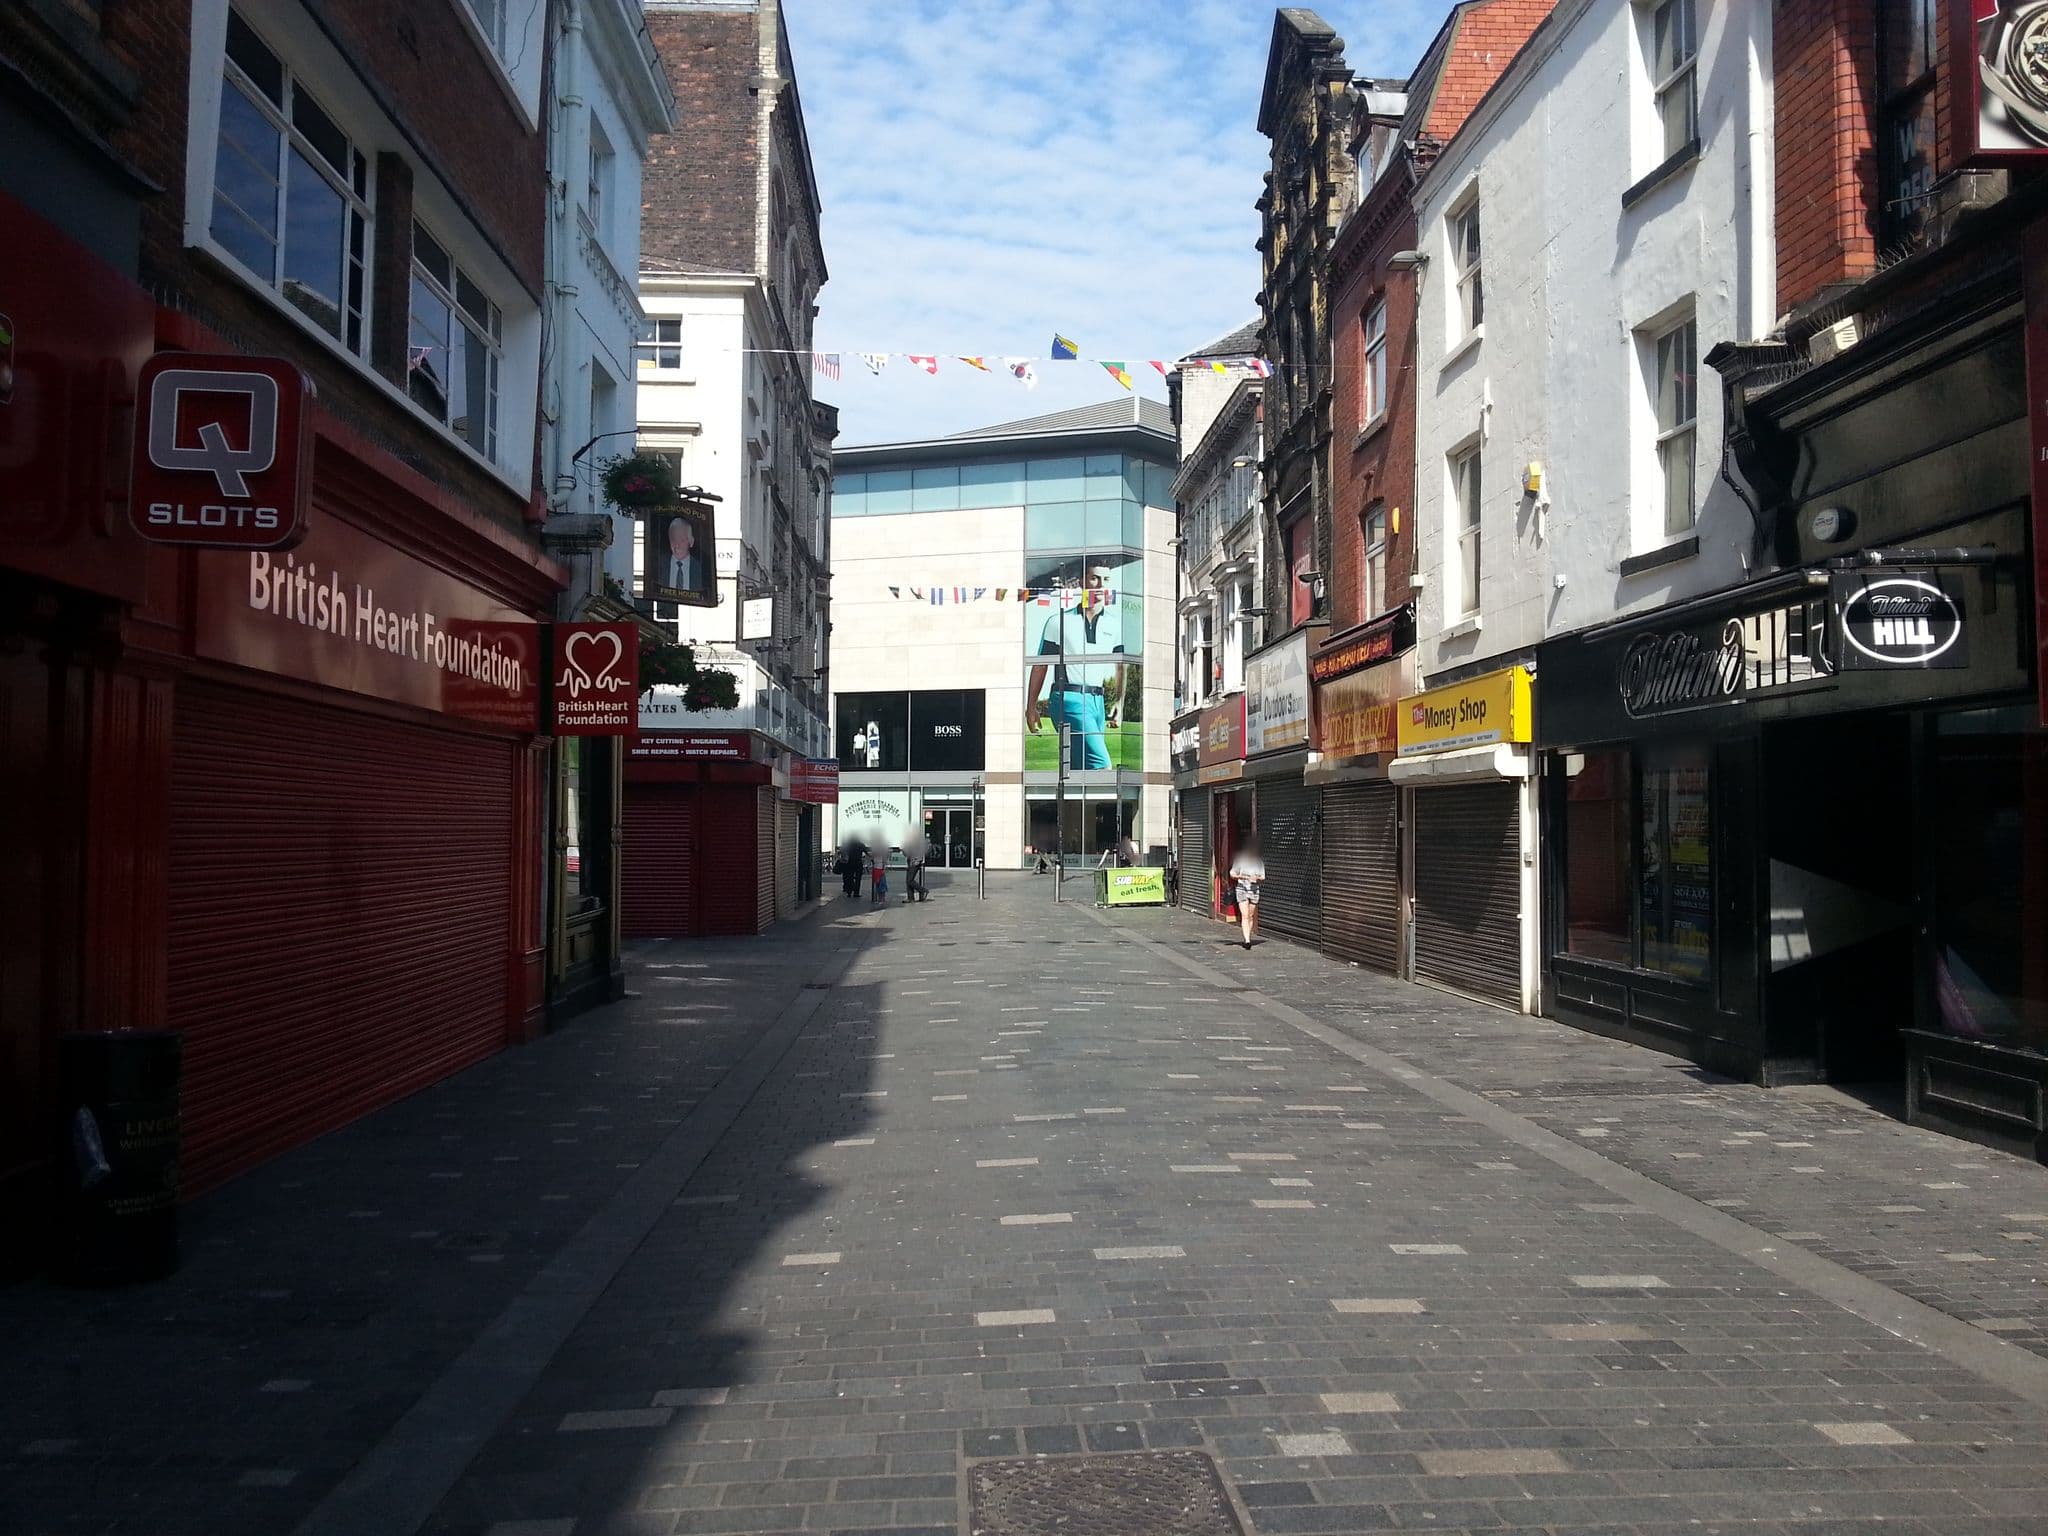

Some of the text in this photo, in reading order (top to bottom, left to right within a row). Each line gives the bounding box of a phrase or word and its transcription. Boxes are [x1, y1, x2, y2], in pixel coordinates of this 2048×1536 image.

[148, 368, 279, 498] Q
[147, 503, 279, 529] SLOTS
[1867, 593, 1933, 617] William
[249, 550, 521, 692] British Heart Foundation
[1872, 617, 1936, 646] HILL
[1620, 602, 1834, 719] William HILL
[557, 700, 629, 714] British Heart
[557, 713, 629, 726] Foundation
[1425, 705, 1457, 732] Money
[1459, 696, 1487, 725] Shop
[934, 725, 962, 735] BOSS
[1113, 875, 1153, 886] SUBWAY
[1120, 888, 1134, 896] eat
